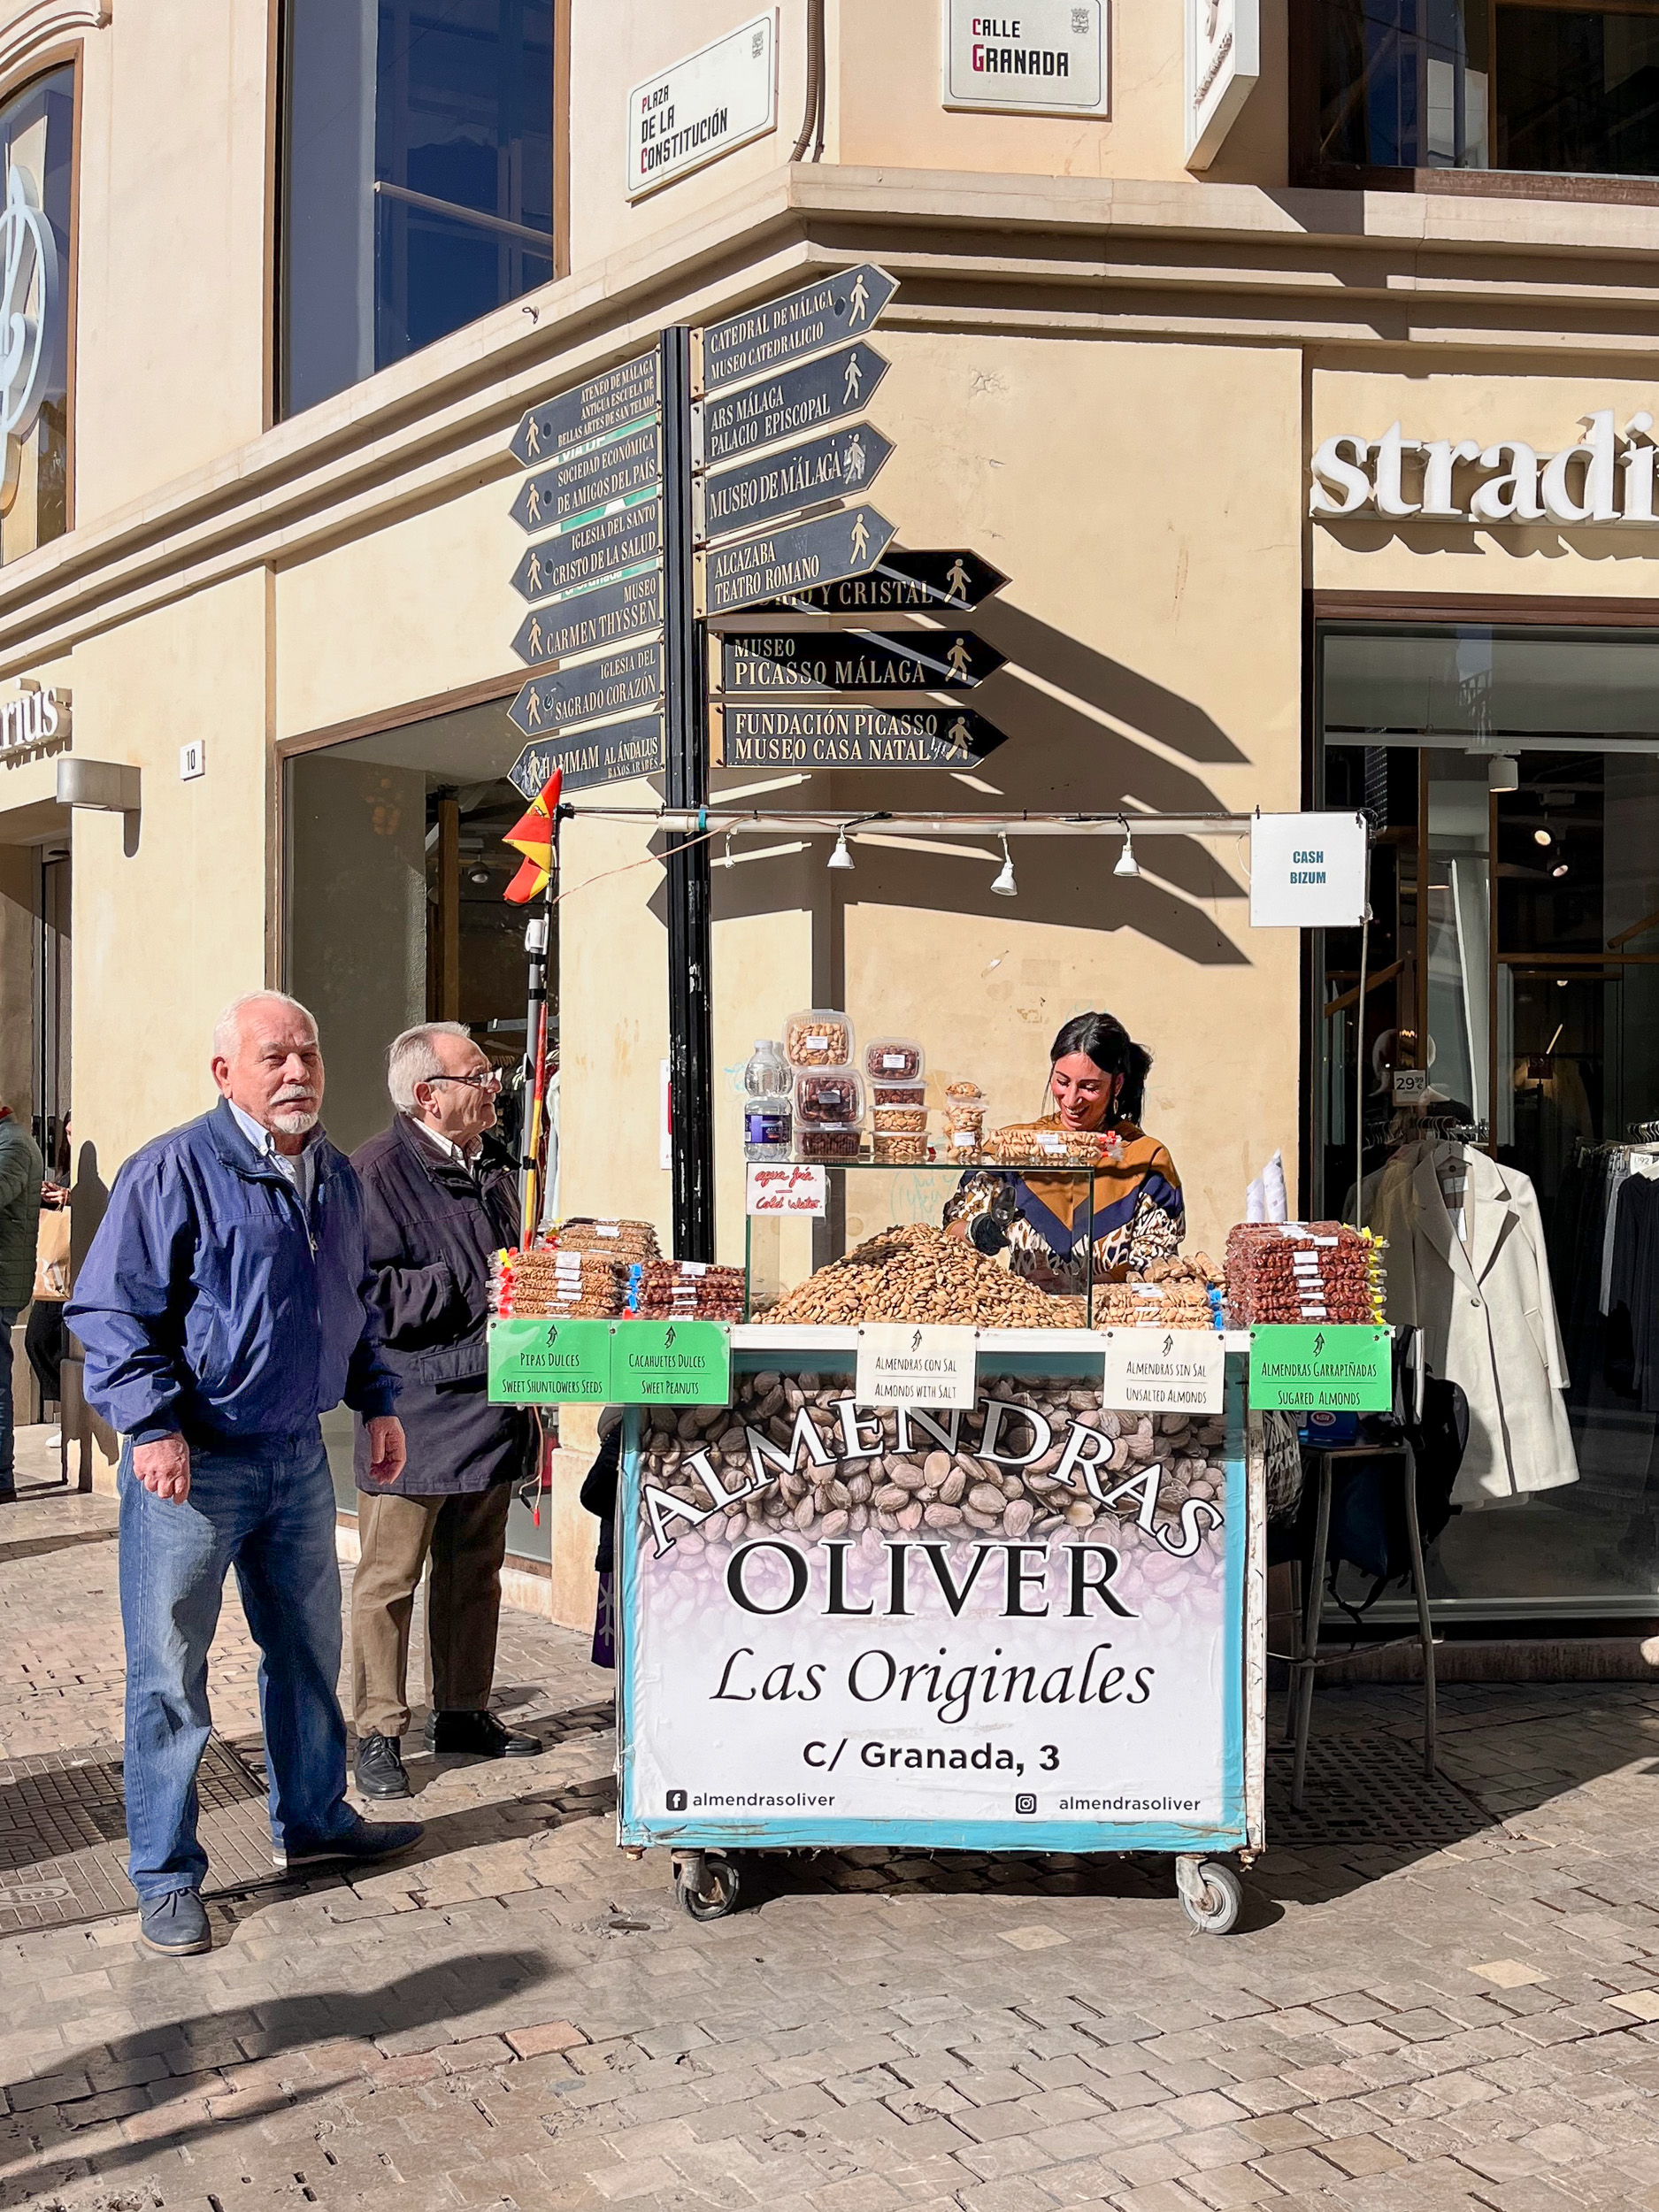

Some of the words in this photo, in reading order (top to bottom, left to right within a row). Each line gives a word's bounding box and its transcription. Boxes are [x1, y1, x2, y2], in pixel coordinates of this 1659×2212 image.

[972, 19, 1020, 38] CALLE
[972, 44, 1069, 76] GRANADA
[641, 85, 669, 114] PLAZA
[641, 115, 657, 143] DE
[660, 104, 674, 134] LA
[641, 107, 727, 173] CONSTITUCIÓN
[710, 314, 770, 354] CATEDRAL
[773, 309, 787, 330] DE
[789, 289, 834, 321] MÁLAGA
[710, 351, 747, 380] MUSEO
[749, 321, 825, 366] CATEDRALICIO
[580, 381, 610, 404] ATENEO
[611, 373, 621, 389] DE
[622, 359, 654, 385] MÁLAGA
[580, 397, 611, 421] ANTIGUA
[611, 385, 643, 405] ESCUELA
[644, 376, 655, 391] DE
[557, 426, 583, 448] BELLAS
[583, 418, 605, 435] ARTES
[605, 411, 615, 426] DE
[616, 406, 629, 422] SAN
[630, 393, 655, 417] TELMO
[710, 403, 733, 432] ARS
[737, 385, 785, 422] MÁLAGA
[710, 420, 759, 457] PALACIO
[764, 393, 831, 437] EPISCOPAL
[558, 452, 601, 488] SOCIEDAD
[602, 434, 655, 469] ECONÓMICA
[1310, 408, 1659, 522] stradi
[557, 493, 571, 515] DE
[572, 477, 611, 508] AMIGOS
[611, 470, 632, 490] DEL
[633, 455, 656, 480] PAÍS
[709, 479, 758, 520] MUSEO
[759, 472, 780, 503] DE
[780, 453, 842, 495] MÁLAGA
[571, 522, 606, 551] IGLESIA
[607, 514, 625, 537] DEL
[626, 503, 656, 528] SANTO
[553, 556, 589, 586] CRISTO
[590, 549, 605, 572] DE
[606, 545, 620, 567] LA
[621, 531, 657, 562] SALUD
[715, 541, 776, 579] ALCAZABA
[623, 577, 657, 603] MUSEO
[715, 572, 762, 605] TEATRO
[765, 554, 820, 591] ROMANO
[840, 580, 933, 605] CRISTAL
[547, 618, 596, 655] CARMEN
[598, 598, 657, 638] THYSSEN
[600, 656, 635, 680] IGLESIA
[637, 649, 657, 670] DEL
[734, 638, 795, 657] MUSEO
[734, 660, 827, 686] PICASSO
[835, 656, 926, 685] MÁLAGA
[555, 688, 605, 721] SAGRADO
[606, 671, 657, 706] CORAZÓN
[0, 678, 58, 750] rius
[735, 709, 849, 735] FUNDACIÓN
[855, 714, 938, 736] PICASSO
[186, 749, 196, 771] 10
[541, 745, 600, 780] HAMMAM
[603, 747, 618, 765] AL
[617, 736, 658, 762] ÁNDALUS
[735, 738, 807, 761] MUSEO
[813, 739, 863, 761] CASA
[869, 739, 932, 761] NATAL
[1293, 851, 1325, 864] CASH
[1290, 872, 1326, 884] BIZUM
[520, 1353, 546, 1367] PIPAS
[548, 1353, 580, 1367] DULCES
[628, 1354, 676, 1368] CACAHUETES
[679, 1354, 706, 1368] DULCES
[875, 1356, 922, 1371] ALMENDRAS
[925, 1359, 941, 1371] CON
[943, 1358, 956, 1372] SAL
[1126, 1361, 1173, 1376] ALMENDRAS
[1176, 1363, 1191, 1377] SIN
[1193, 1363, 1207, 1378] SAL
[1262, 1362, 1311, 1377] ALMENDRAS
[1313, 1362, 1377, 1378] GARRAPIÑADAS
[502, 1379, 525, 1394] SWEET
[581, 1379, 603, 1394] SEEDS
[641, 1380, 664, 1394] SWEET
[665, 1380, 699, 1395] PEANUTS
[875, 1383, 914, 1397] ALMONDS
[916, 1386, 936, 1398] WITH
[939, 1385, 956, 1399] SALT
[1126, 1387, 1165, 1402] UNSALTED
[1168, 1389, 1207, 1404] ALMONDS
[1278, 1390, 1314, 1405] SUGARED
[1318, 1390, 1361, 1406] ALMONDS
[640, 1396, 1225, 1560] ALMENDRAS
[726, 1540, 1141, 1619] OLIVER
[709, 1647, 827, 1704] Las
[848, 1641, 1156, 1724] Originales
[803, 1738, 849, 1773] C/
[860, 1741, 1025, 1777] Granada,
[1040, 1745, 1060, 1771] 3
[693, 1793, 835, 1807] almendrasoliver
[1059, 1796, 1202, 1810] almendrasoliver
